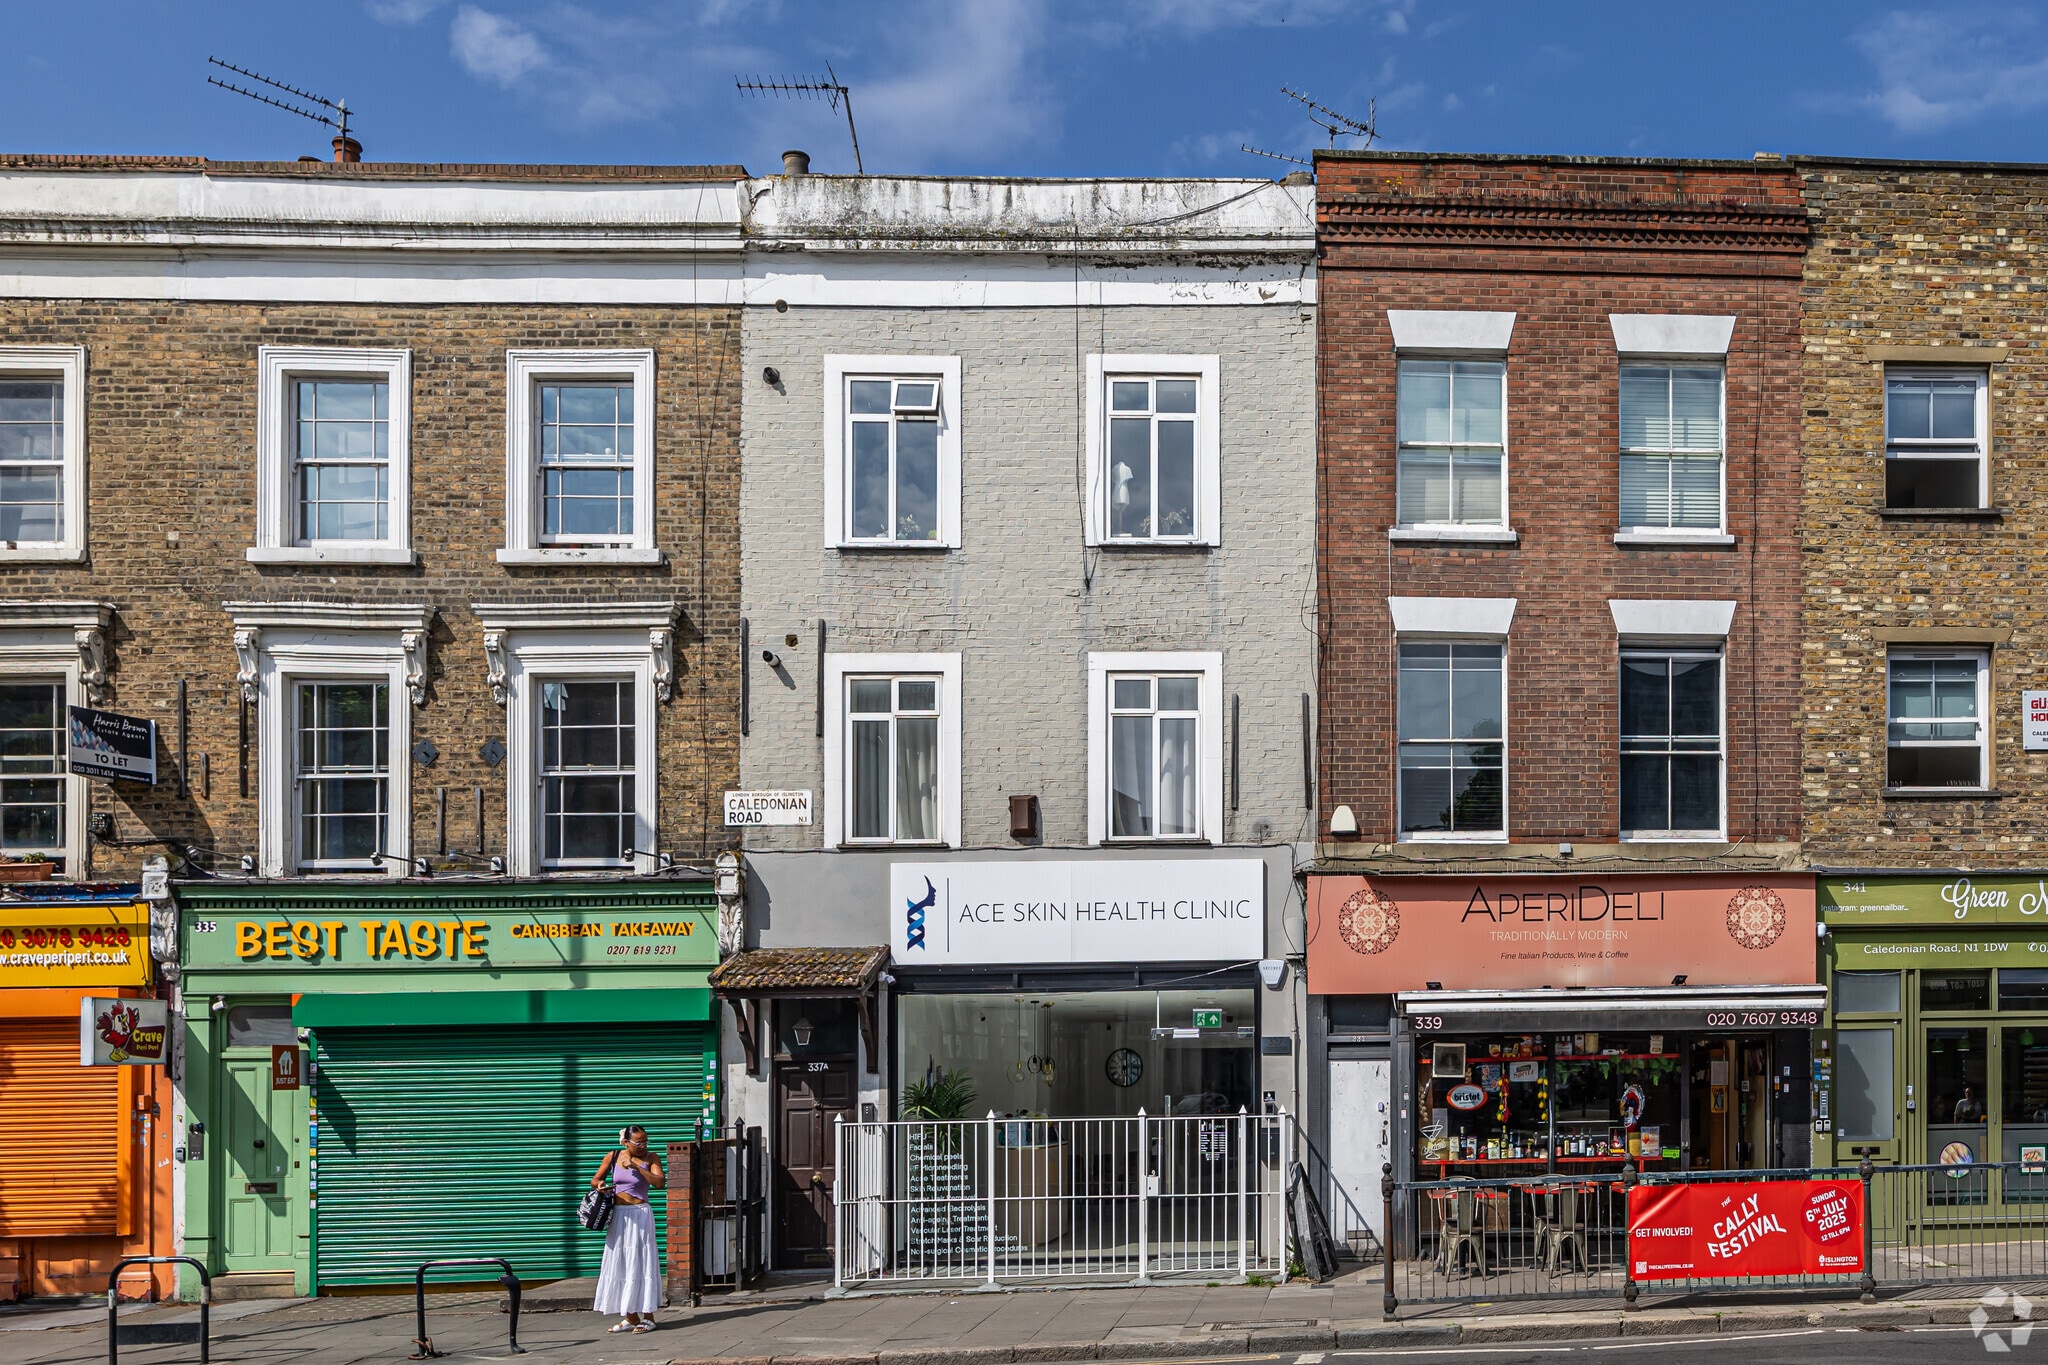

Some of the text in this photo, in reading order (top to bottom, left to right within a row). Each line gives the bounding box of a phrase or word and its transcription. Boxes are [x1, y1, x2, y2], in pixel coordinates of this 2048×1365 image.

[2031, 697, 2048, 709] GÜ
[93, 714, 148, 733] Harris Brown
[97, 727, 145, 740] Estate Agents
[94, 753, 129, 767] TO LET
[73, 765, 115, 777] 020 3011 1414
[729, 798, 807, 810] CALEDONIAN
[729, 812, 763, 823] ROAD
[1842, 882, 1867, 893] 341
[1941, 877, 2010, 919] Green
[958, 899, 1251, 923] ACE SKIN HEALTH CLINIC
[1821, 904, 1858, 913] Instagram:
[194, 921, 217, 932] 335
[510, 922, 696, 939] CARIBBEAN TAKEAWAY
[0, 926, 130, 947] 0 3078 9428
[235, 920, 487, 958] BEST TASTE
[1490, 930, 1628, 942] TRADITIONALLY MODERN
[606, 945, 677, 955] 0207 619 9231
[1863, 944, 1926, 954] Caledonian
[1929, 944, 1961, 954] Road,
[1964, 943, 1979, 952] N1
[1983, 942, 2009, 952] 1DW
[1500, 950, 1629, 961] Fine Italian Products, Wine & Coffee
[1415, 1016, 1442, 1030] 339
[1707, 1011, 1817, 1026] 020 7607 9348
[132, 1029, 162, 1043] Crave
[808, 1062, 829, 1072] 337A
[275, 1077, 287, 1085] JUST
[1721, 1196, 1732, 1208] THE
[1811, 1190, 1836, 1204] SUNDAY
[948, 1204, 986, 1212] Elecrolysis
[1822, 1197, 1848, 1217] JULY
[1713, 1193, 1759, 1239] CALLY
[1818, 1211, 1847, 1231] 2025
[911, 1226, 940, 1234] Vacular
[941, 1225, 961, 1233] Lser
[1635, 1227, 1693, 1238] GET INVOLVED!
[1707, 1213, 1787, 1258] FESTIVAL
[983, 1234, 1018, 1242] Rducion
[1821, 1234, 1829, 1242] 12
[1828, 1230, 1840, 1239] TILL
